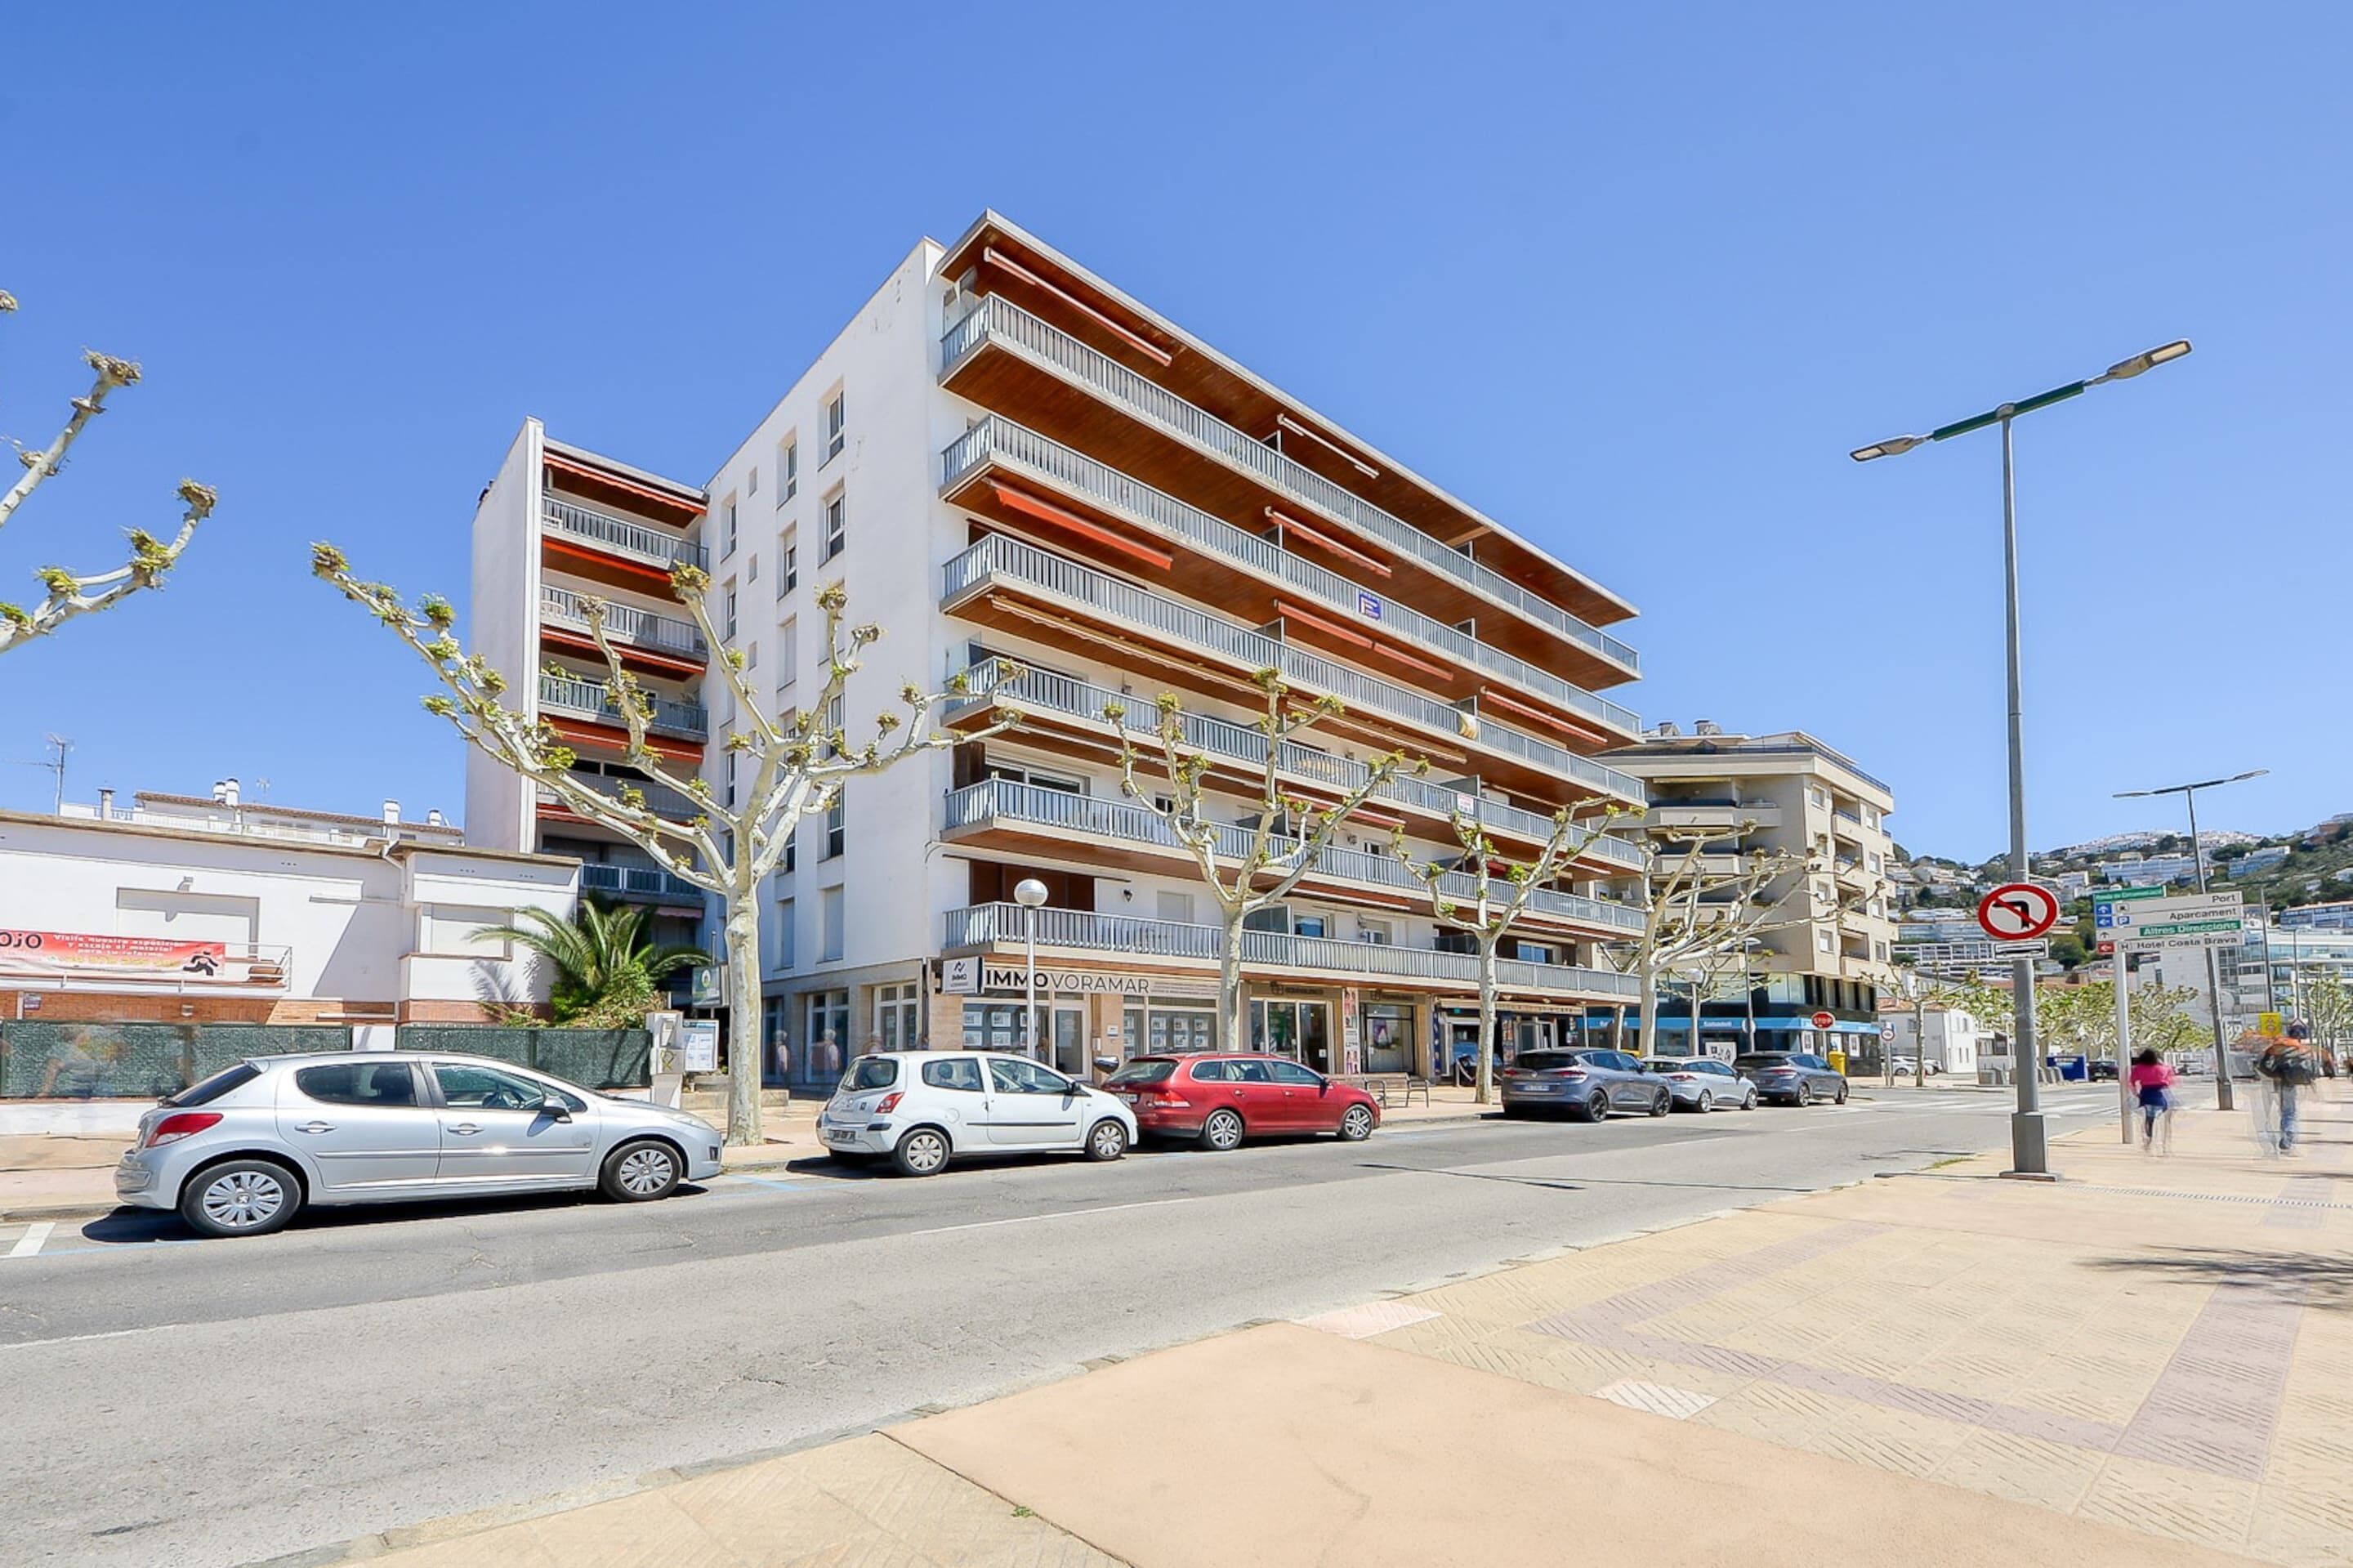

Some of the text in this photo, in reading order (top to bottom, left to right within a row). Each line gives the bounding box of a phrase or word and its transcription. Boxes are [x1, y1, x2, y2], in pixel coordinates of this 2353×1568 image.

[2212, 895, 2236, 904] Port
[2169, 908, 2237, 921] Aparcament
[2143, 921, 2238, 936] Altres Direccions
[2136, 940, 2165, 949] Hotel
[2168, 938, 2201, 948] Costa
[2204, 936, 2238, 945] Brava
[1815, 1016, 1833, 1025] STOP
